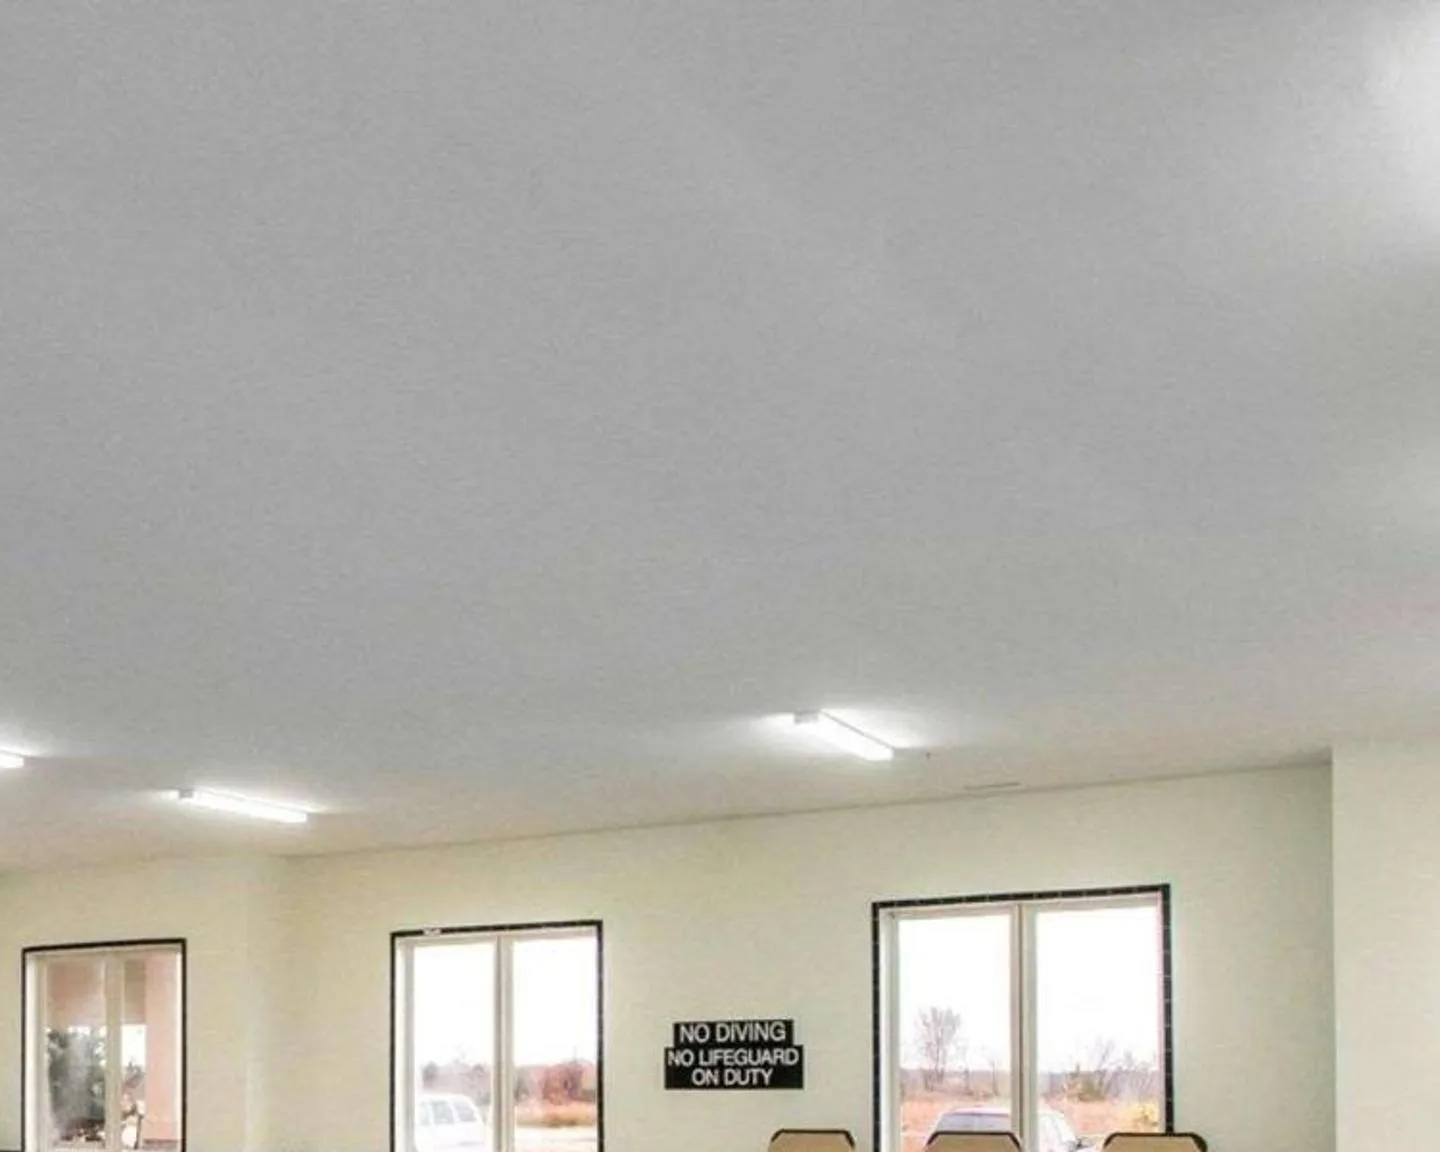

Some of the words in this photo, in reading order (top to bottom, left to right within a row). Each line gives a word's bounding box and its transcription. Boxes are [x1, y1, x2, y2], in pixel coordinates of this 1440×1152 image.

[679, 1024, 710, 1043] NO
[715, 1020, 787, 1042] DIVING
[667, 1050, 695, 1067] NO
[699, 1048, 800, 1066] LIFEGUARD
[691, 1068, 719, 1086] ON
[723, 1067, 774, 1086] DUTY
